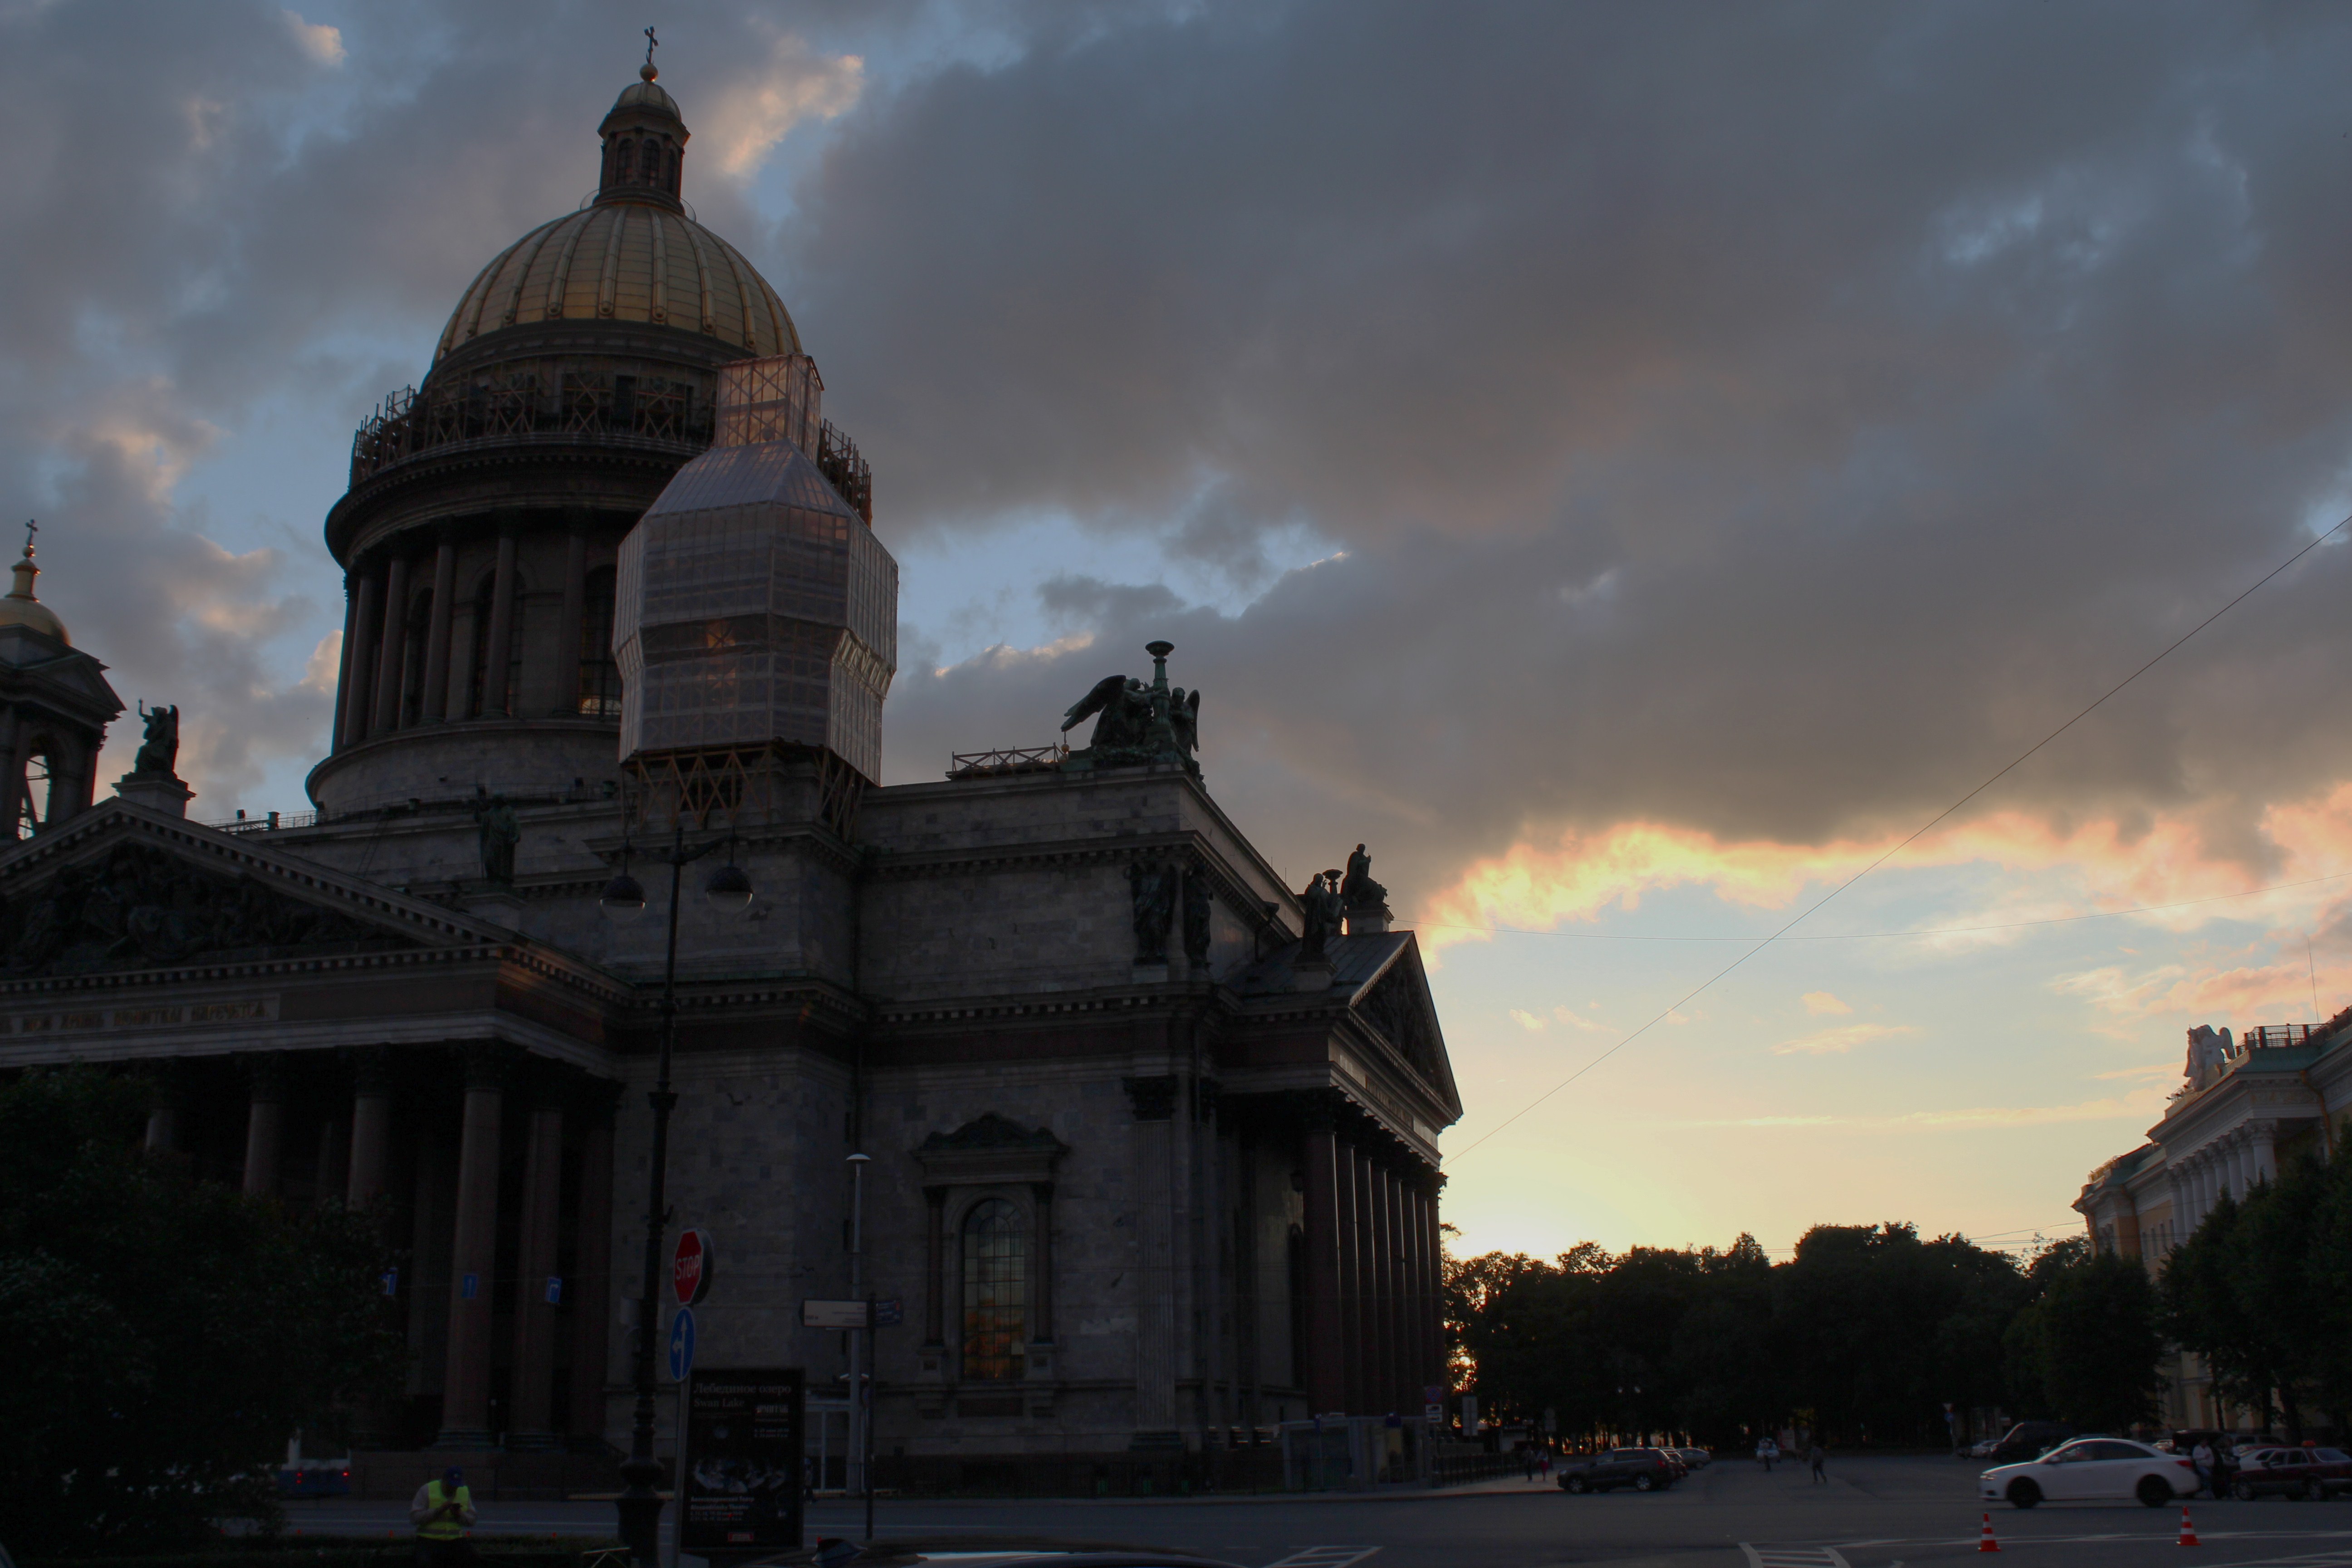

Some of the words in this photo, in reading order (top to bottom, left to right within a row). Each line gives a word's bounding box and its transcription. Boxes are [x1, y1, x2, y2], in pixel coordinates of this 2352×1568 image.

[676, 1254, 700, 1281] STOP
[693, 1382, 756, 1394] Лебединое
[759, 1385, 792, 1396] озеро
[694, 1397, 719, 1407] Swan
[722, 1397, 745, 1407] Lake
